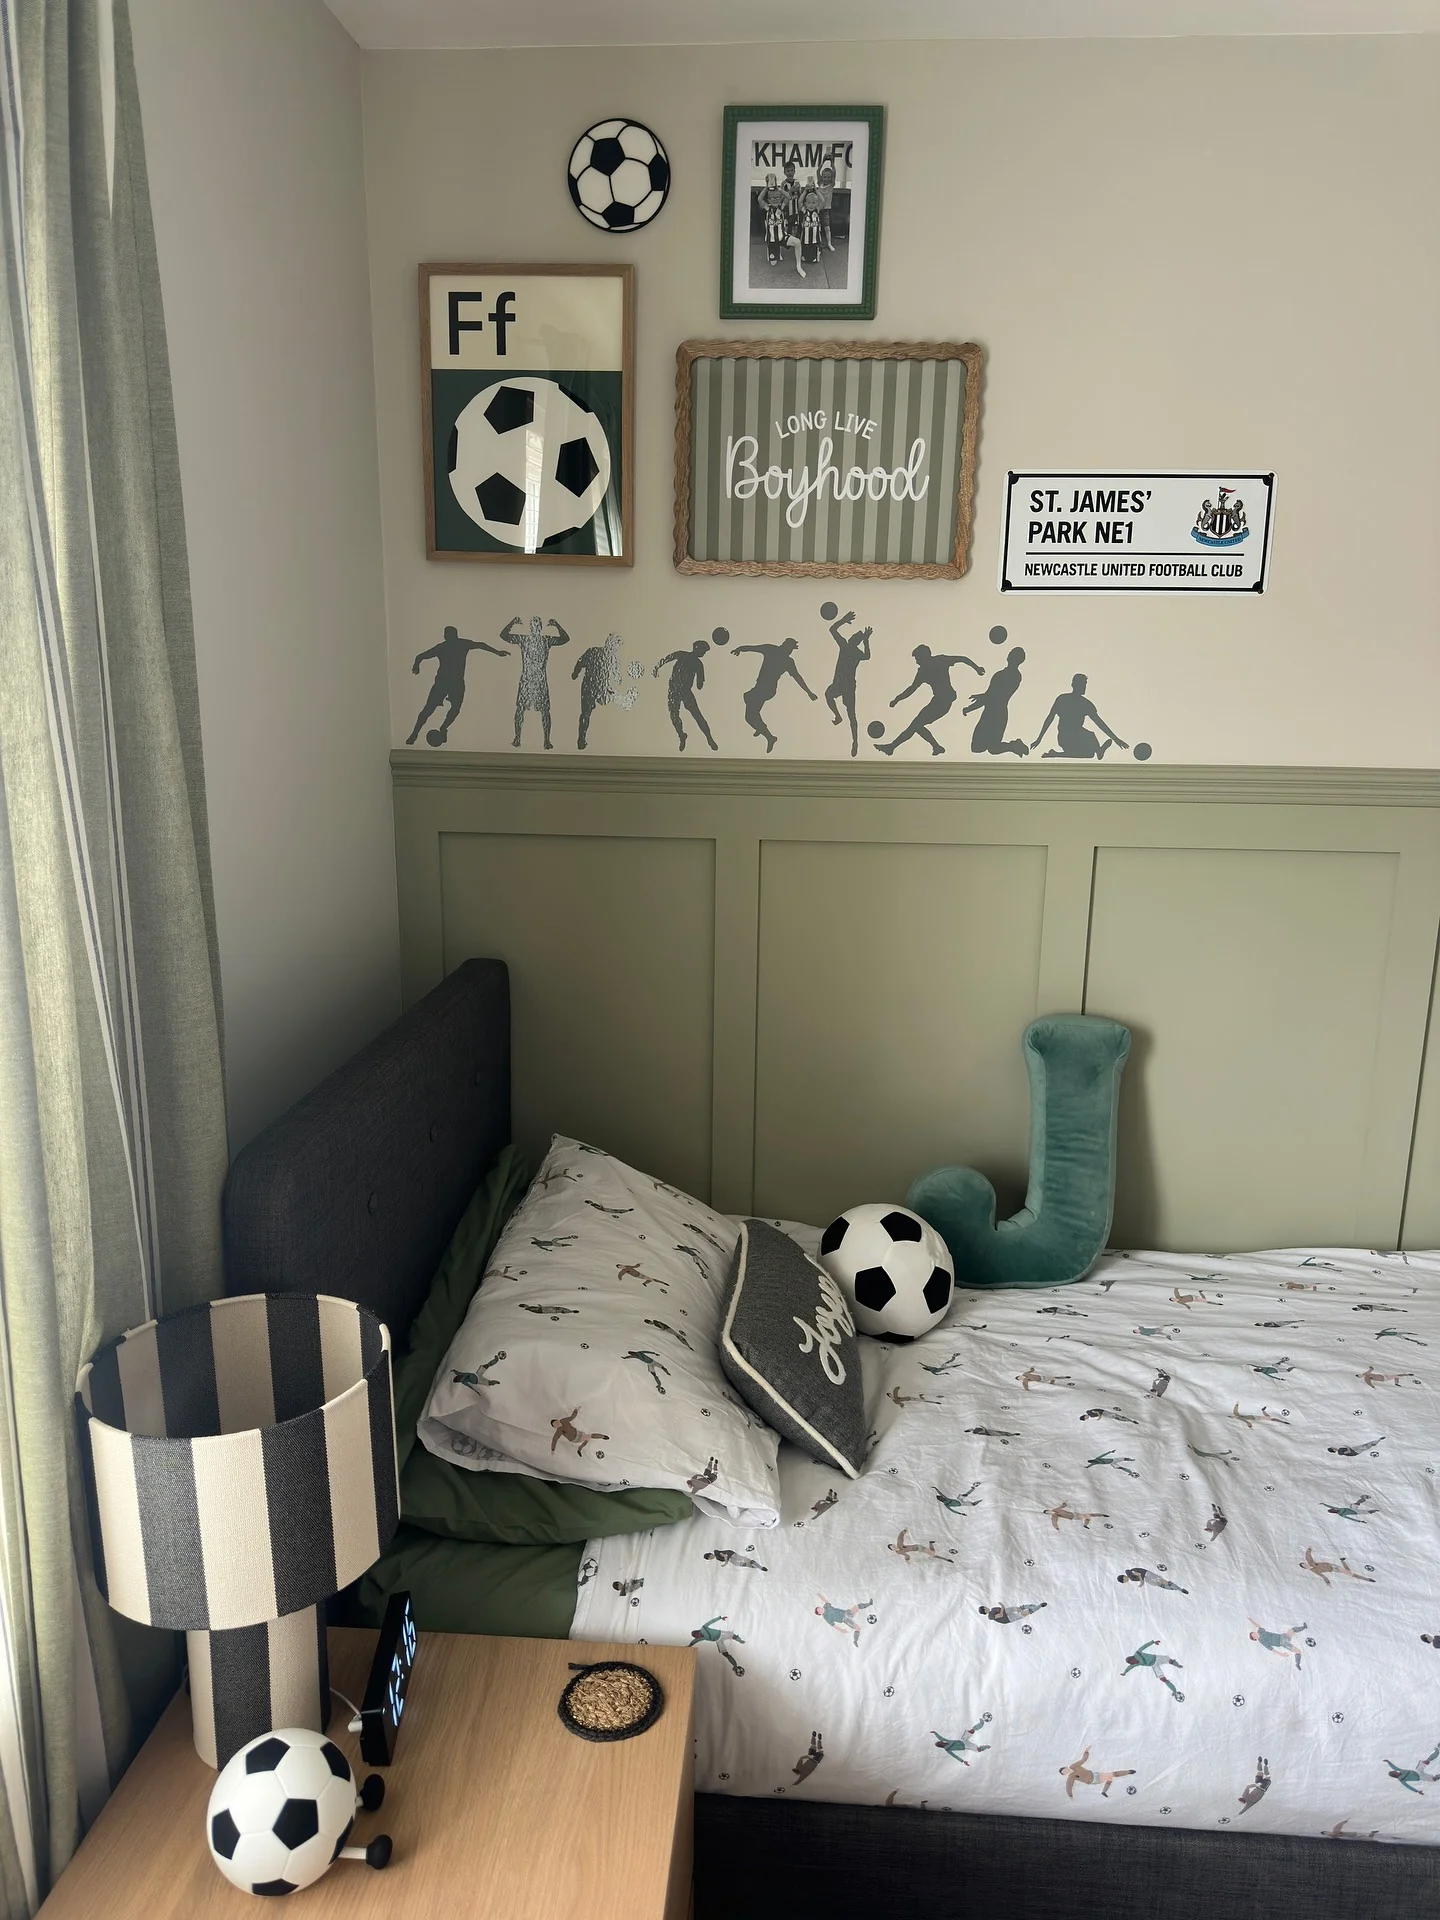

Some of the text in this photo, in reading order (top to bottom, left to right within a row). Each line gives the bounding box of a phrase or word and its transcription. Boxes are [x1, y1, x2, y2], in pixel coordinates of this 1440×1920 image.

[448, 291, 516, 356] Ff
[775, 409, 878, 440] LONG LIVE
[726, 435, 930, 529] Boyhood
[1029, 490, 1063, 513] ST.
[1028, 521, 1134, 544] PARK NE1
[1024, 563, 1243, 578] NEWCASTLE UNITED FOOTBALL CLUB
